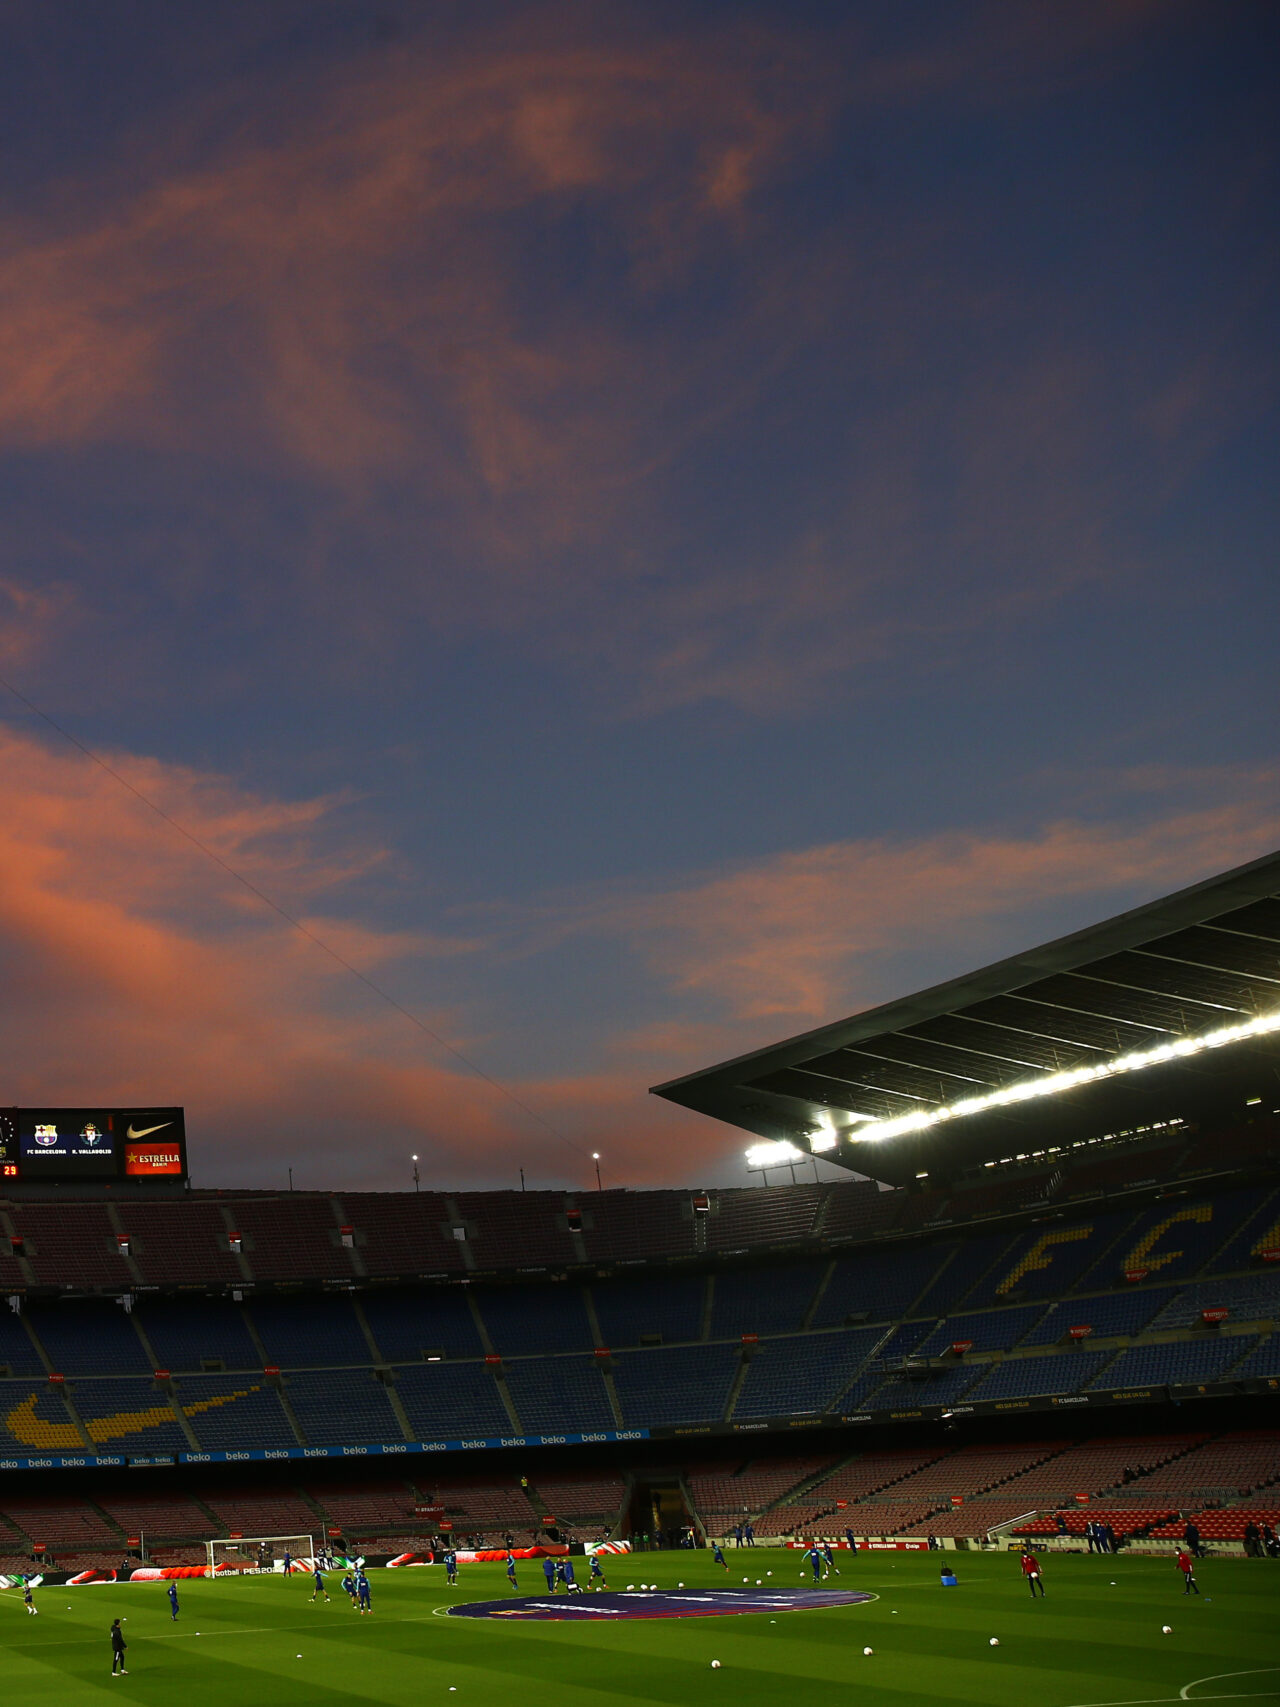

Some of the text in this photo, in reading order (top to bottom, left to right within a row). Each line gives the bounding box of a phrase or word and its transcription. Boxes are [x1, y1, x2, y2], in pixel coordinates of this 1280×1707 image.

[139, 1154, 180, 1163] ESTRELLA
[4, 1165, 17, 1175] 29
[541, 1435, 566, 1444] beko
[581, 1433, 607, 1442] beko
[616, 1431, 641, 1440] beko
[422, 1442, 446, 1451] beko
[462, 1440, 486, 1449] beko
[501, 1437, 526, 1447] beko
[304, 1448, 328, 1457] beko
[343, 1446, 367, 1455] beko
[382, 1444, 407, 1453] beko
[186, 1453, 210, 1462] beko
[226, 1451, 250, 1460] beko
[264, 1450, 289, 1459] beko
[28, 1458, 52, 1467] beko
[61, 1458, 85, 1466] beko
[96, 1456, 120, 1465] beko
